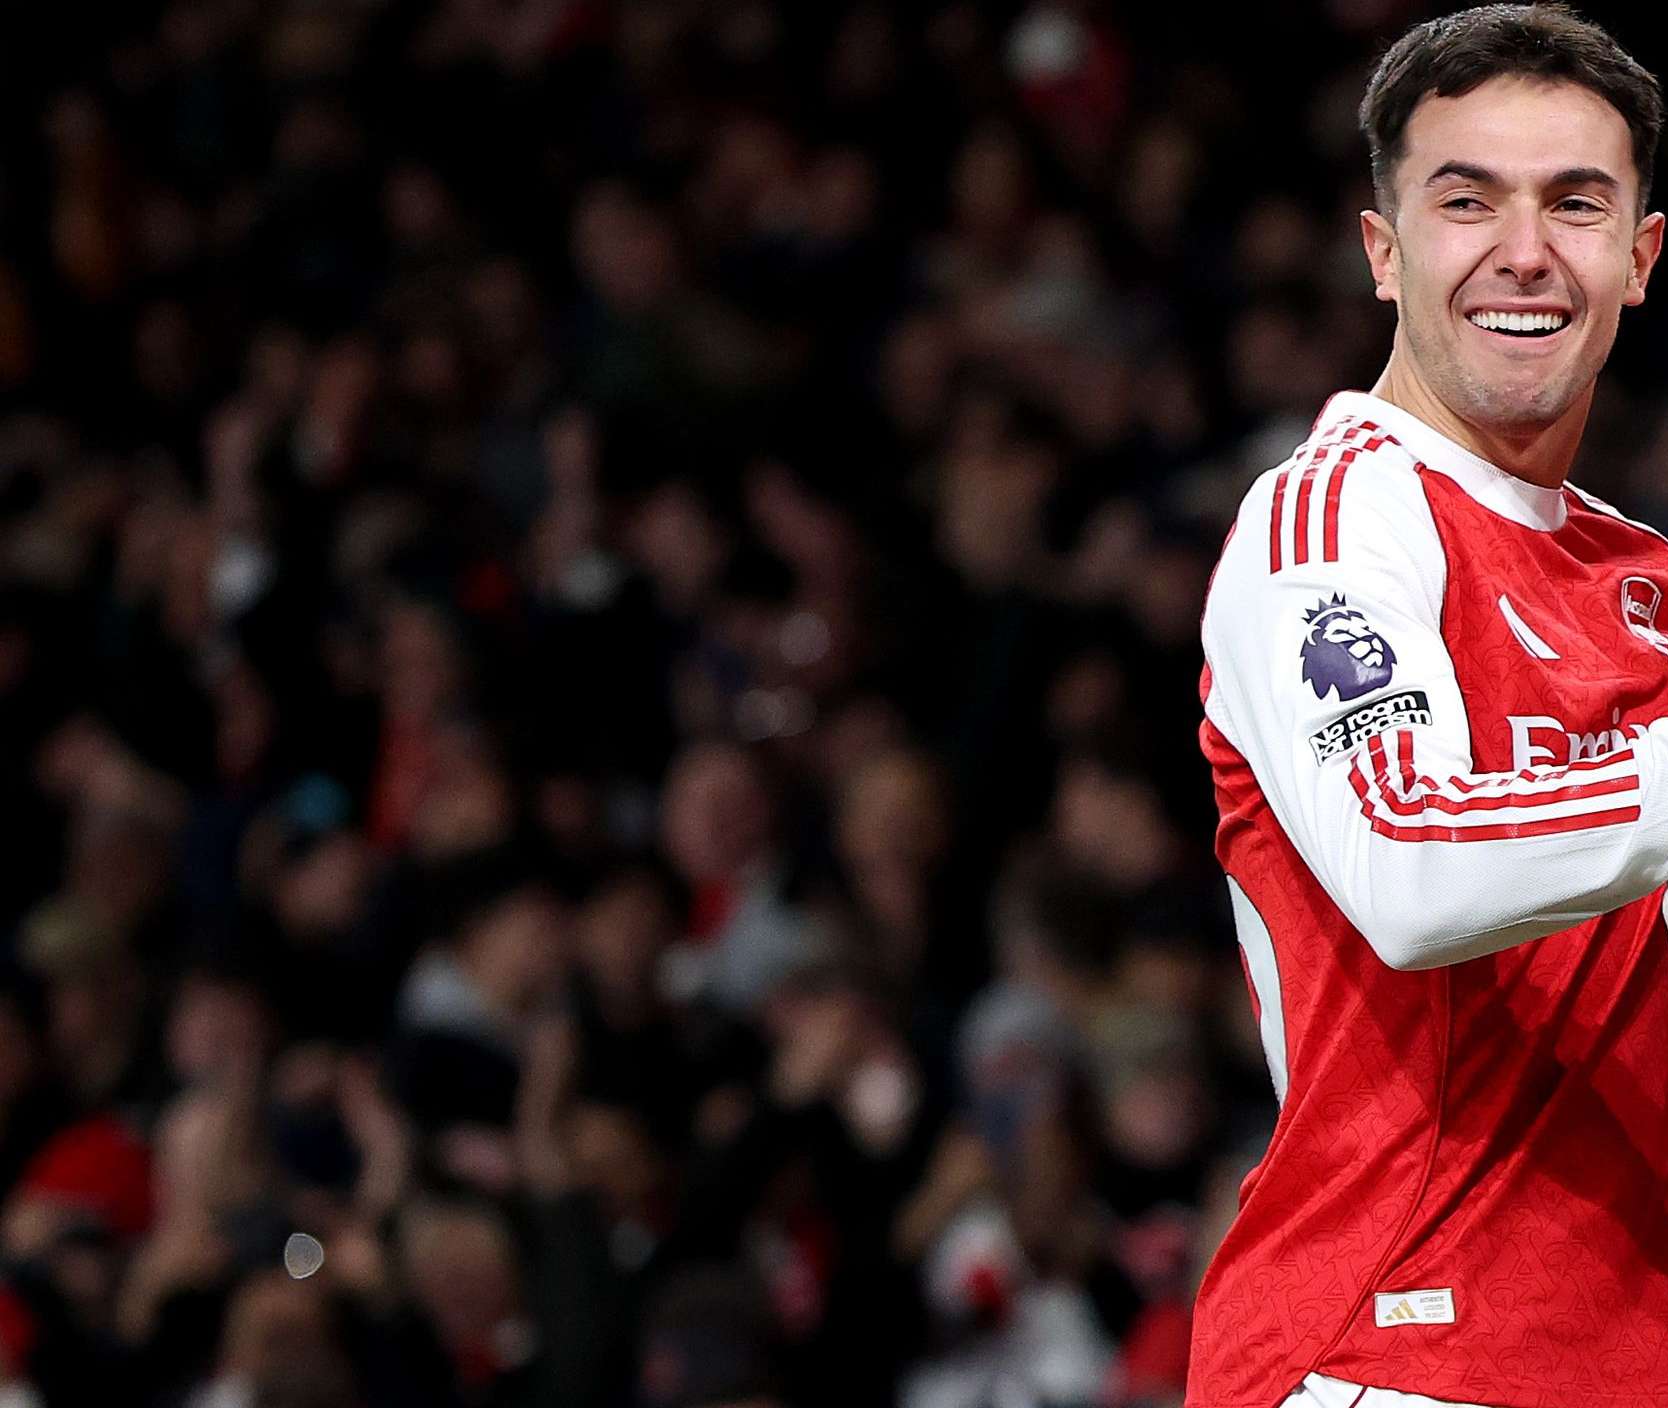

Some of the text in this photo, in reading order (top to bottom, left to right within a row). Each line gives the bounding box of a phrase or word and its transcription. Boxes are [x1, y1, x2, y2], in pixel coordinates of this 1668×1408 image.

[1310, 694, 1419, 750] No room
[1317, 709, 1432, 762] for racism
